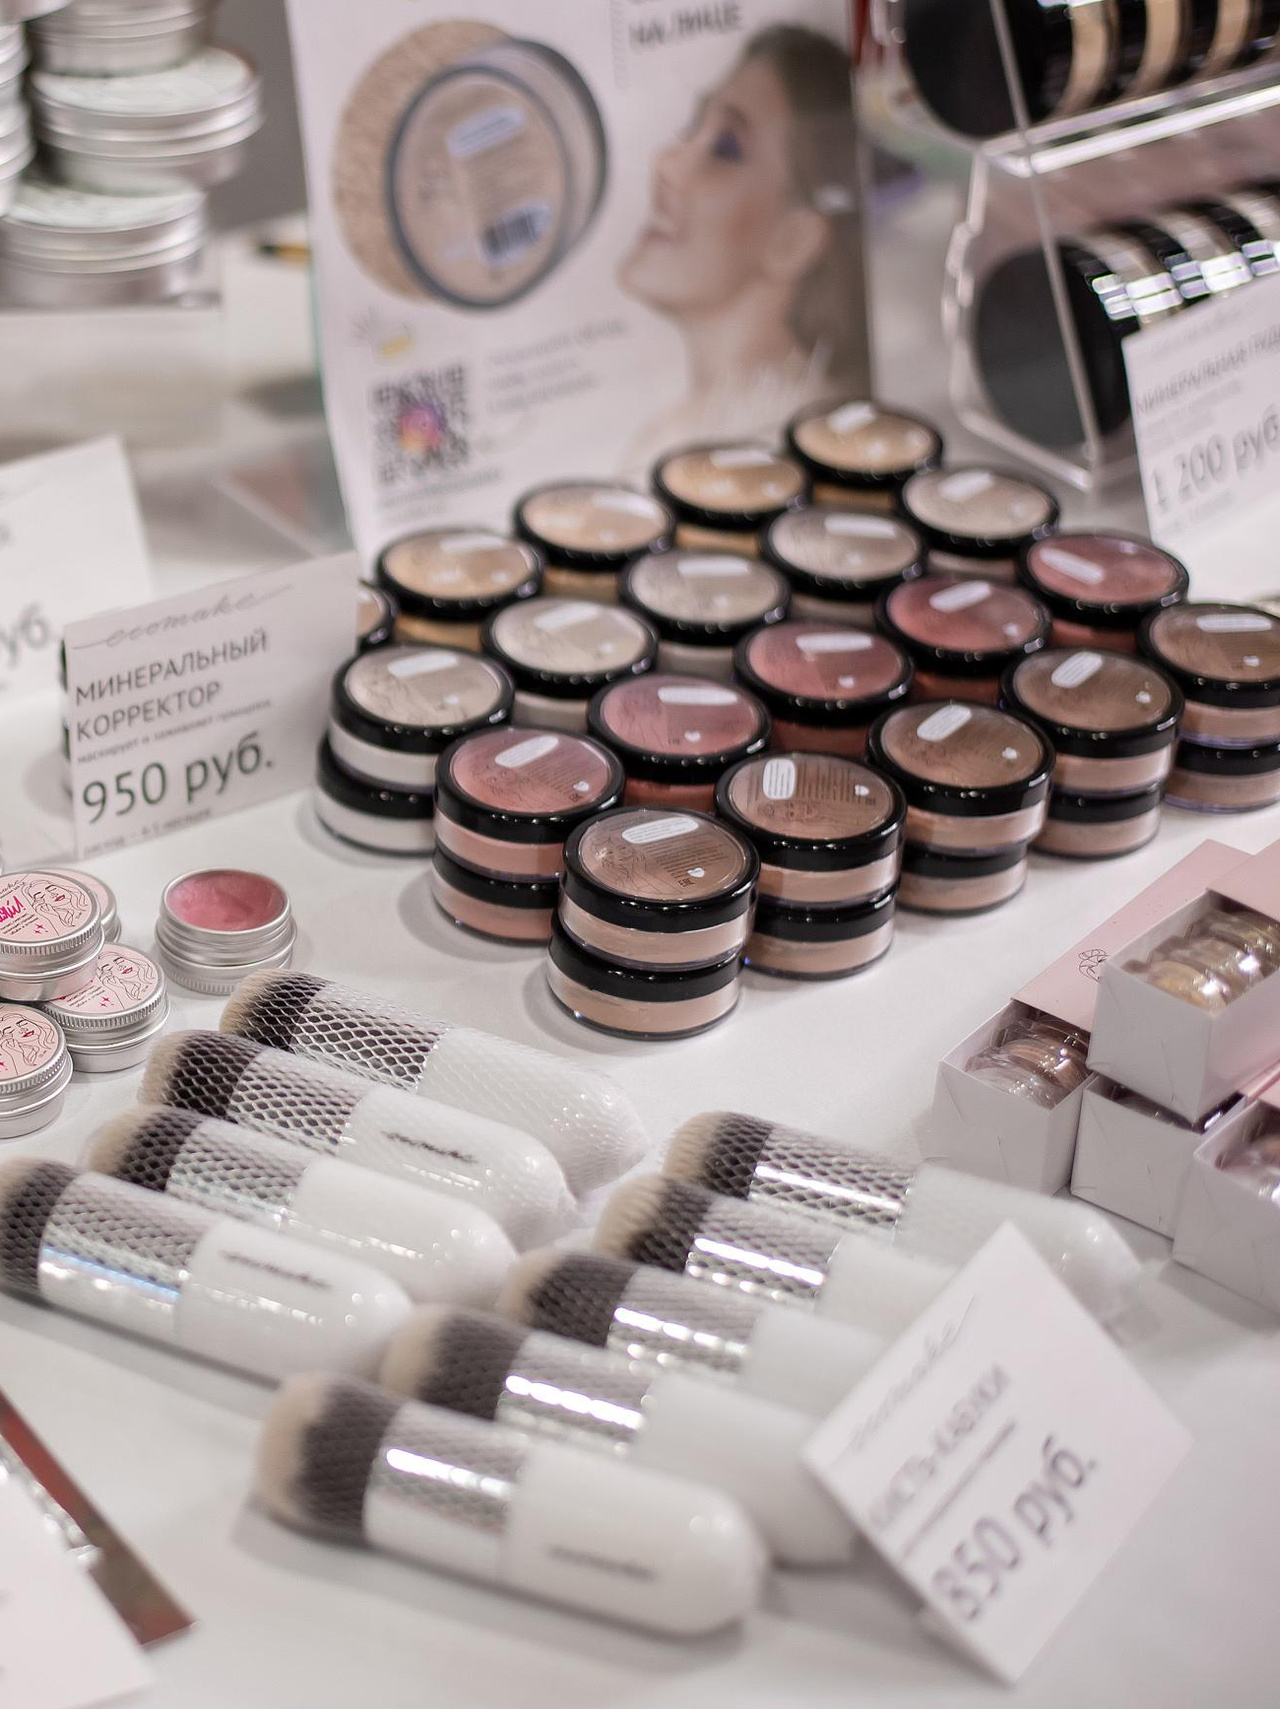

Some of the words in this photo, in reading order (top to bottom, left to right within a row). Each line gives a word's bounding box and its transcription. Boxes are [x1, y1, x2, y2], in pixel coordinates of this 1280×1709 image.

[76, 627, 268, 707] МИНЕРАЛЬНЫЙ
[77, 680, 221, 742] КОРРЕКТОР
[82, 761, 167, 825] 950
[185, 730, 275, 805] руб.
[932, 1515, 1020, 1622] 850
[1013, 1432, 1098, 1550] руб.
